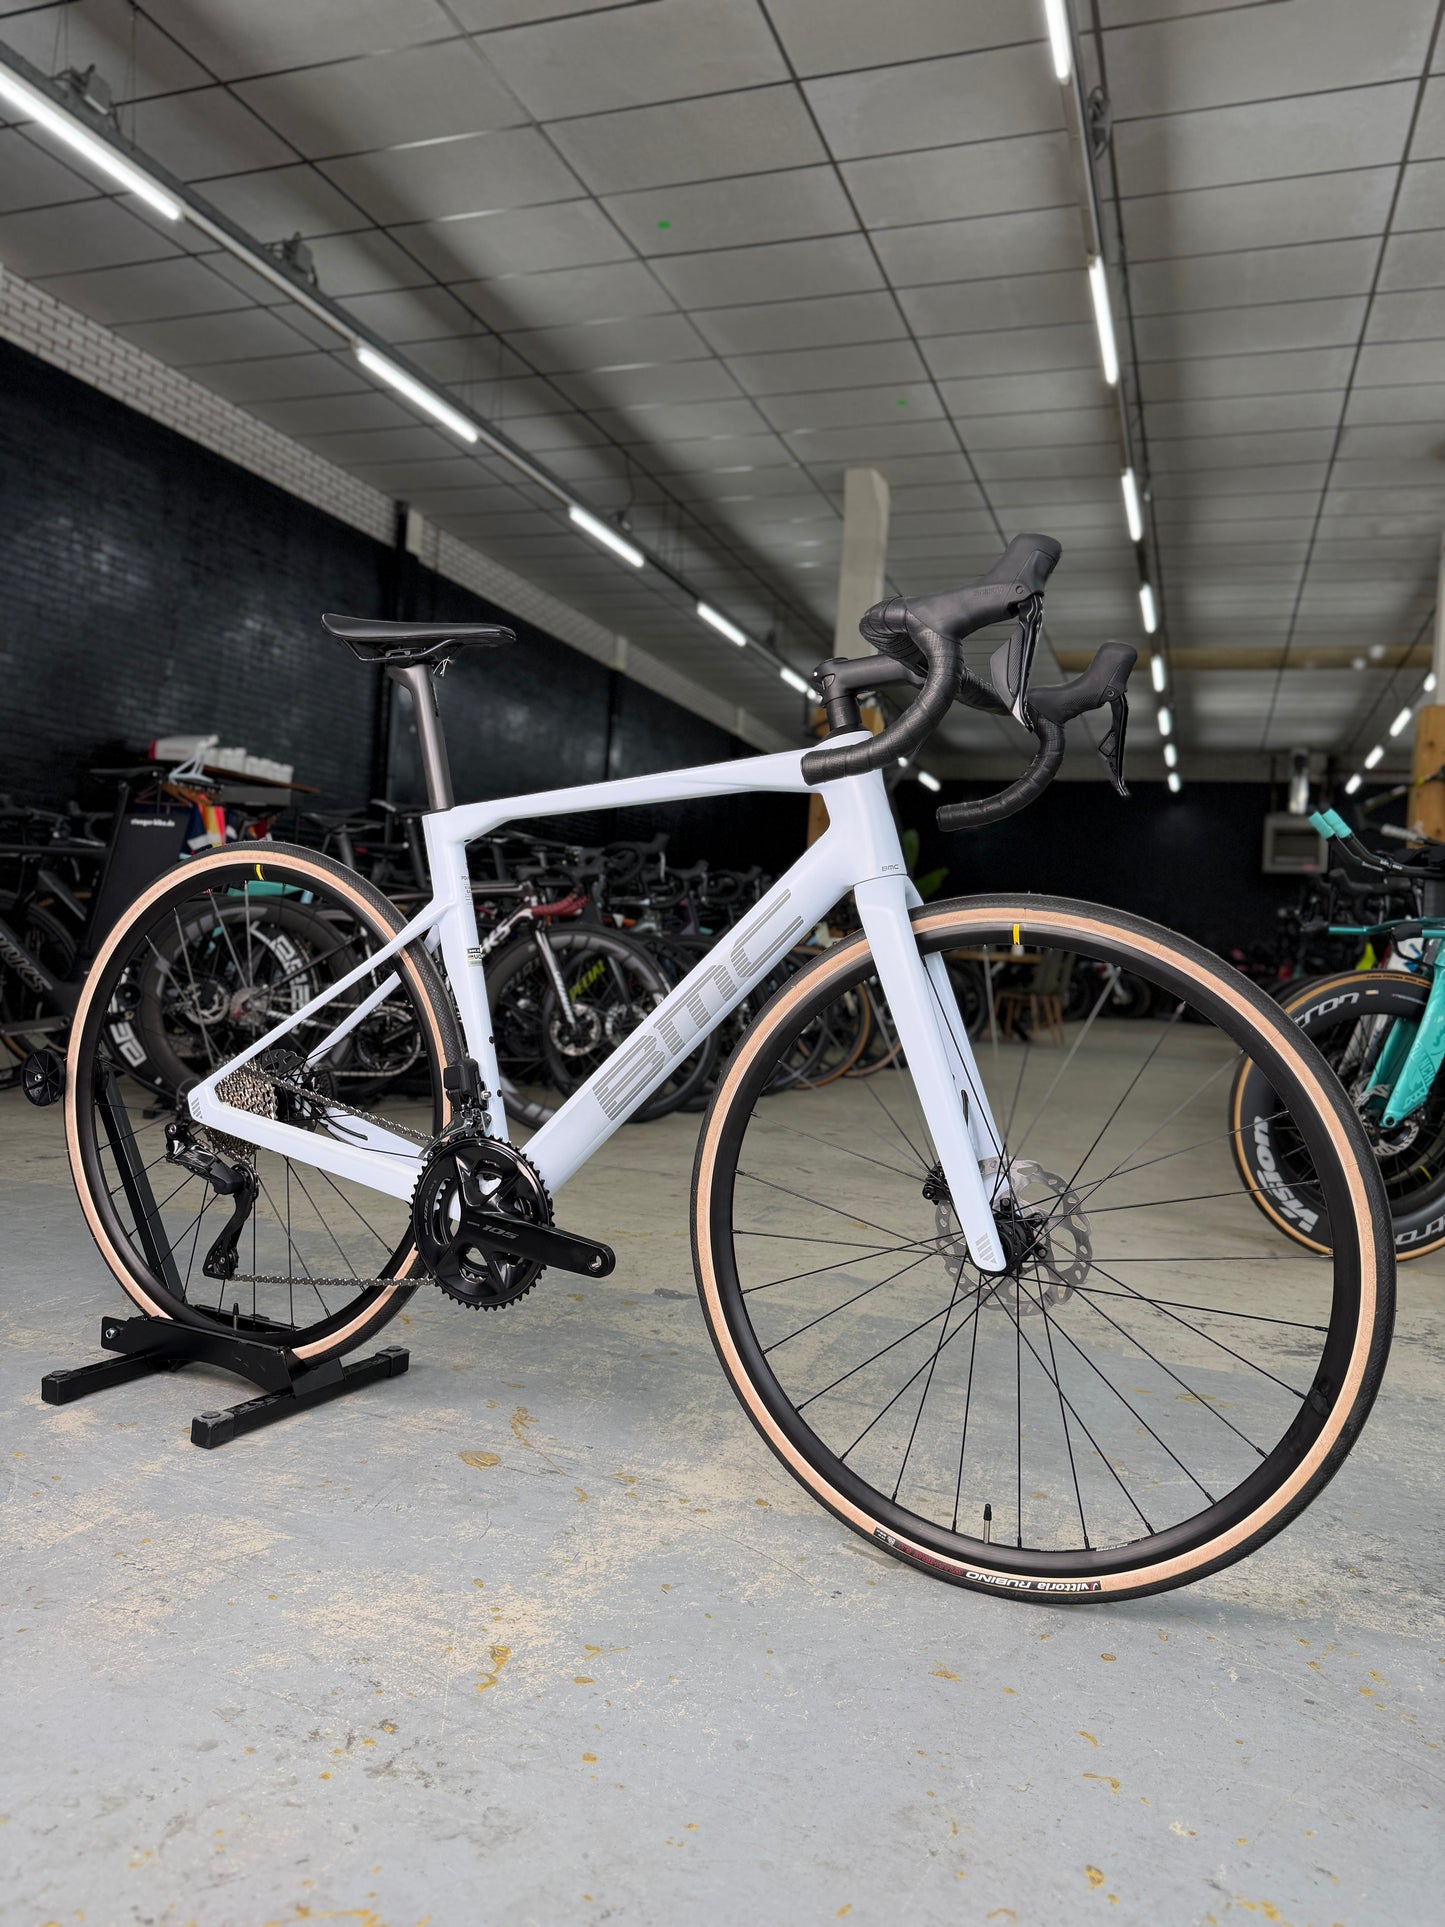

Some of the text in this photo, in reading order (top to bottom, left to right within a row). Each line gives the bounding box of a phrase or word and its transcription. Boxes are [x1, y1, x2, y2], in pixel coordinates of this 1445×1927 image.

[881, 864, 900, 872] BMC
[1294, 992, 1360, 1028] tron
[482, 1224, 520, 1240] 105
[965, 1571, 1089, 1592] vittoria RUBINO
